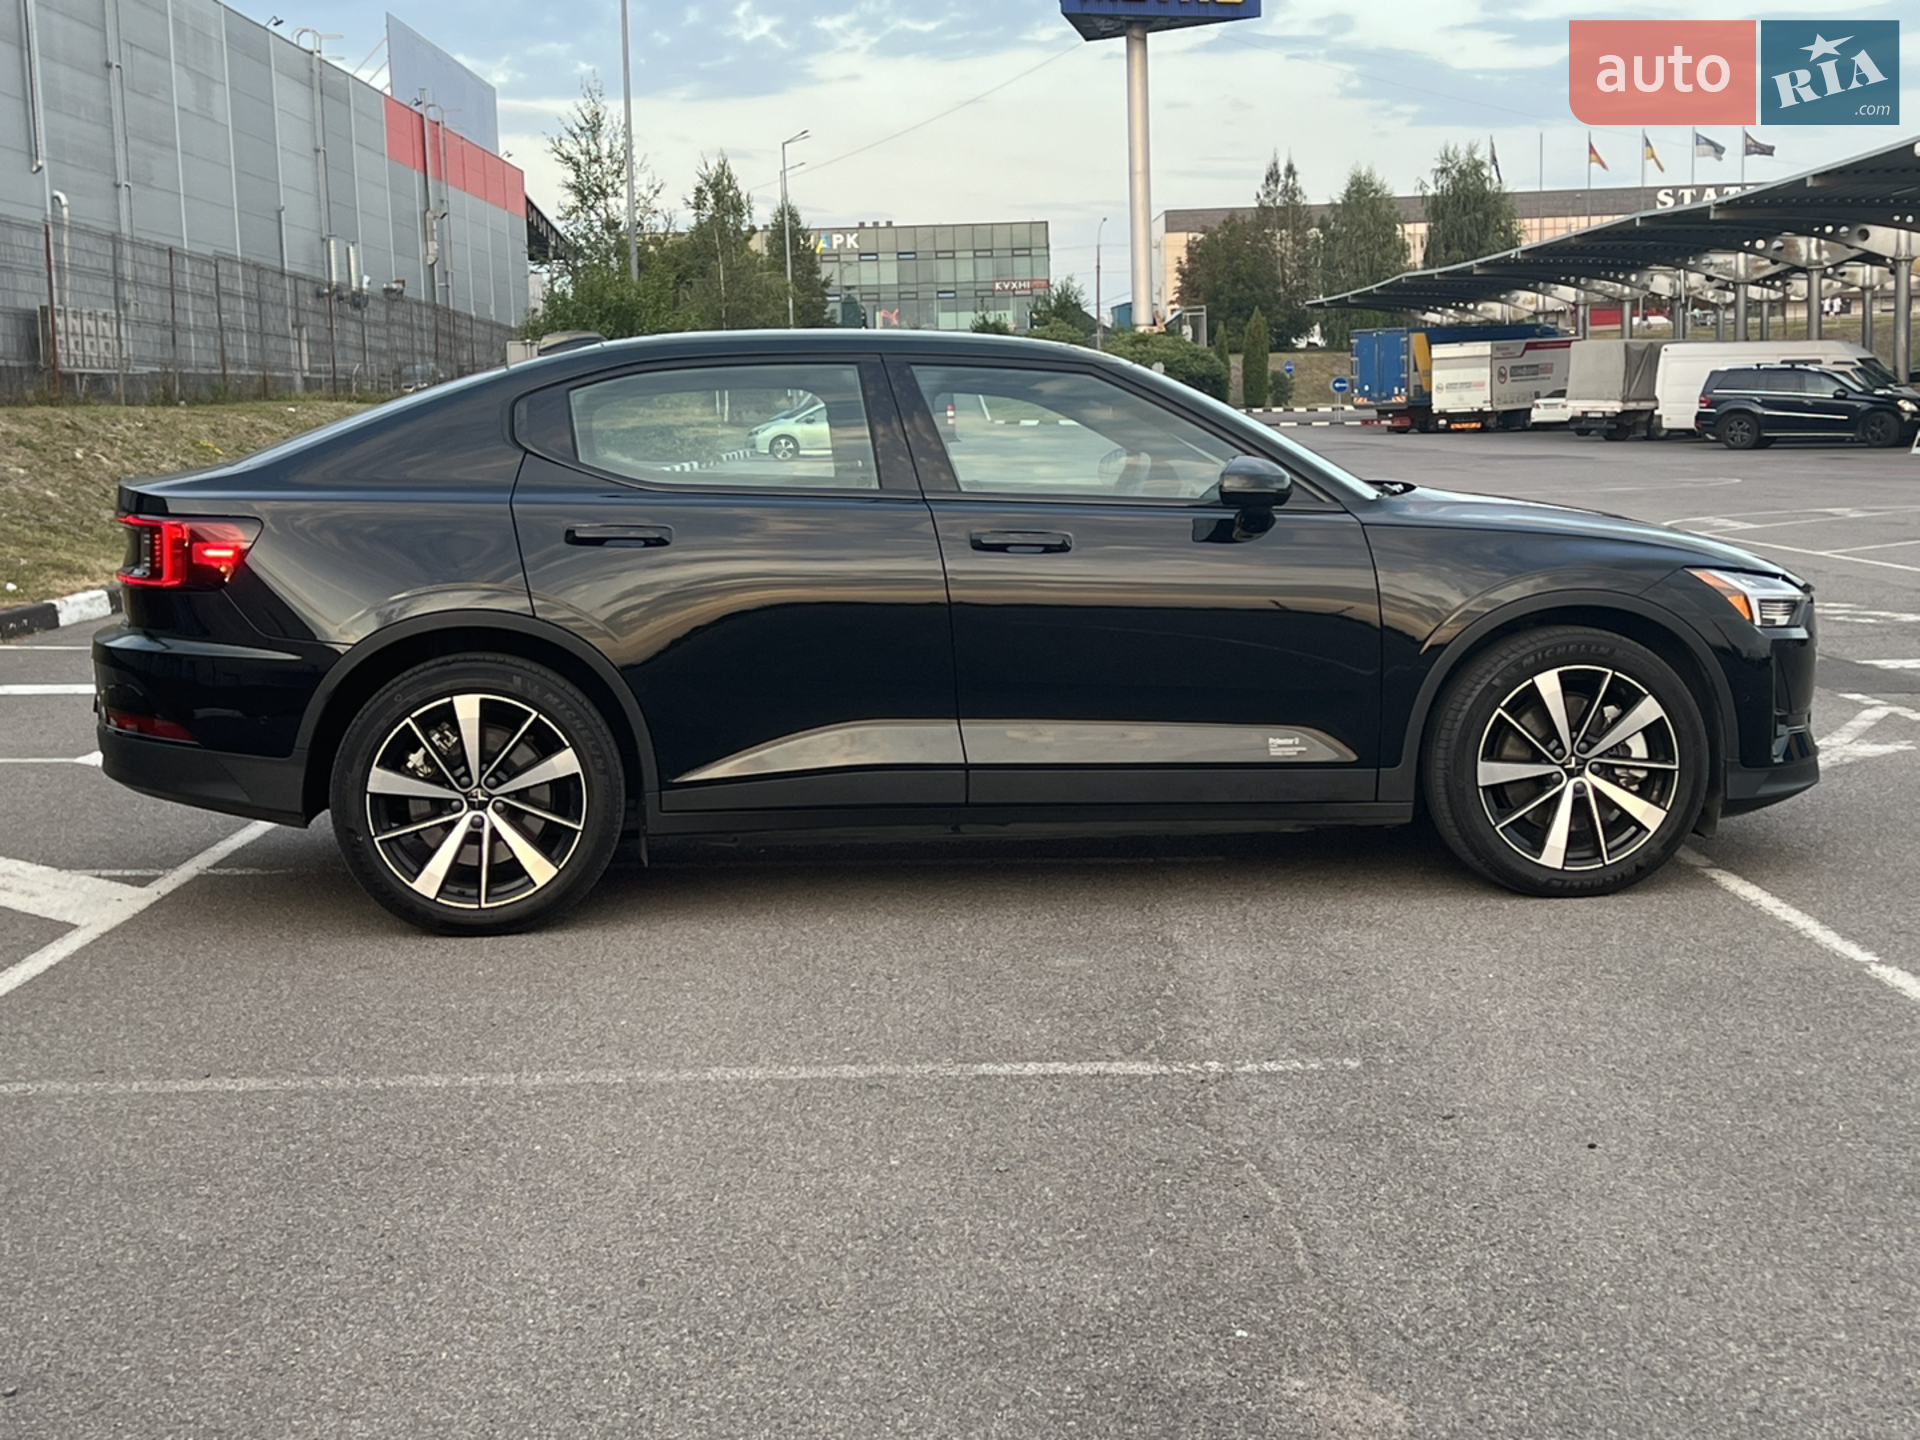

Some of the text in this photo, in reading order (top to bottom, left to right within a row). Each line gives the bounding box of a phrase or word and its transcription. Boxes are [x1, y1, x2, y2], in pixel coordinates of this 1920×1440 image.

[1656, 185, 1756, 210] STAT
[1522, 643, 1614, 668] MICHELIN
[543, 692, 607, 773] MICHELIN
